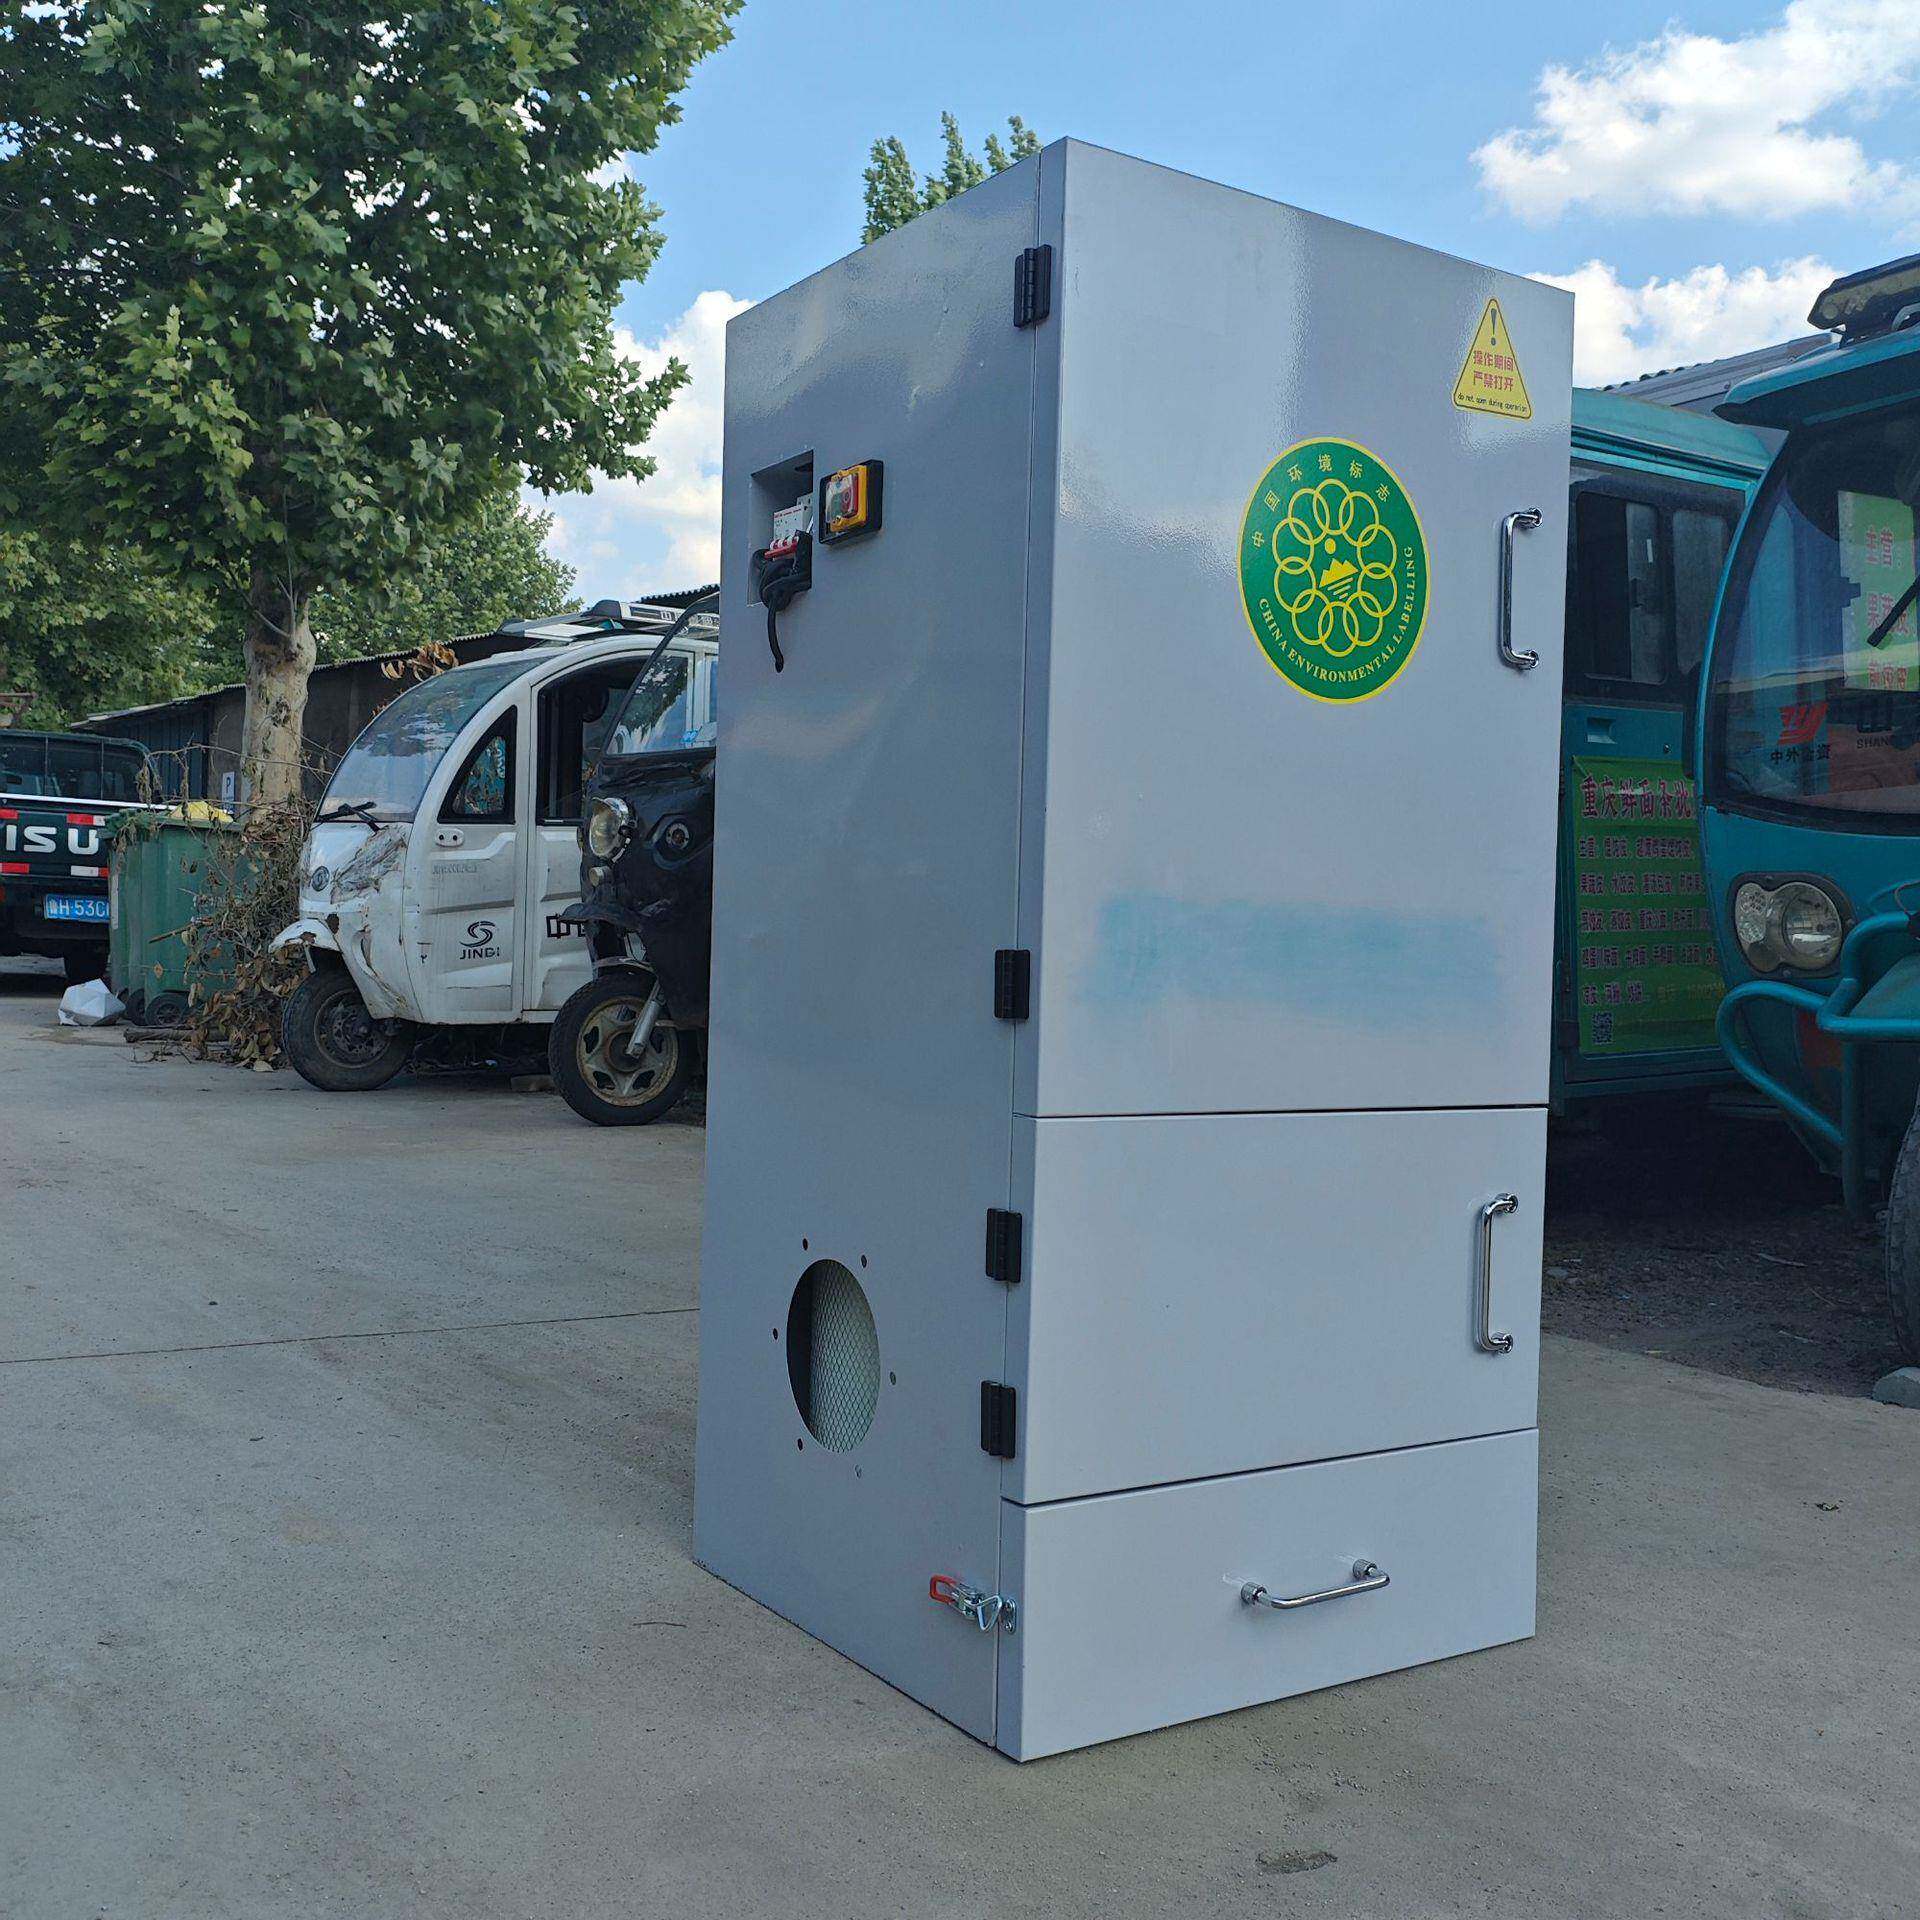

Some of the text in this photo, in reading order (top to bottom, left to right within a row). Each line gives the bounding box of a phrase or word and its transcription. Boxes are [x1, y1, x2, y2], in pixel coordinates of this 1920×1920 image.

[1473, 370, 1514, 392] 严禁打开
[1258, 546, 1416, 683] CHINA ENVIRONMENTAL LABELLING
